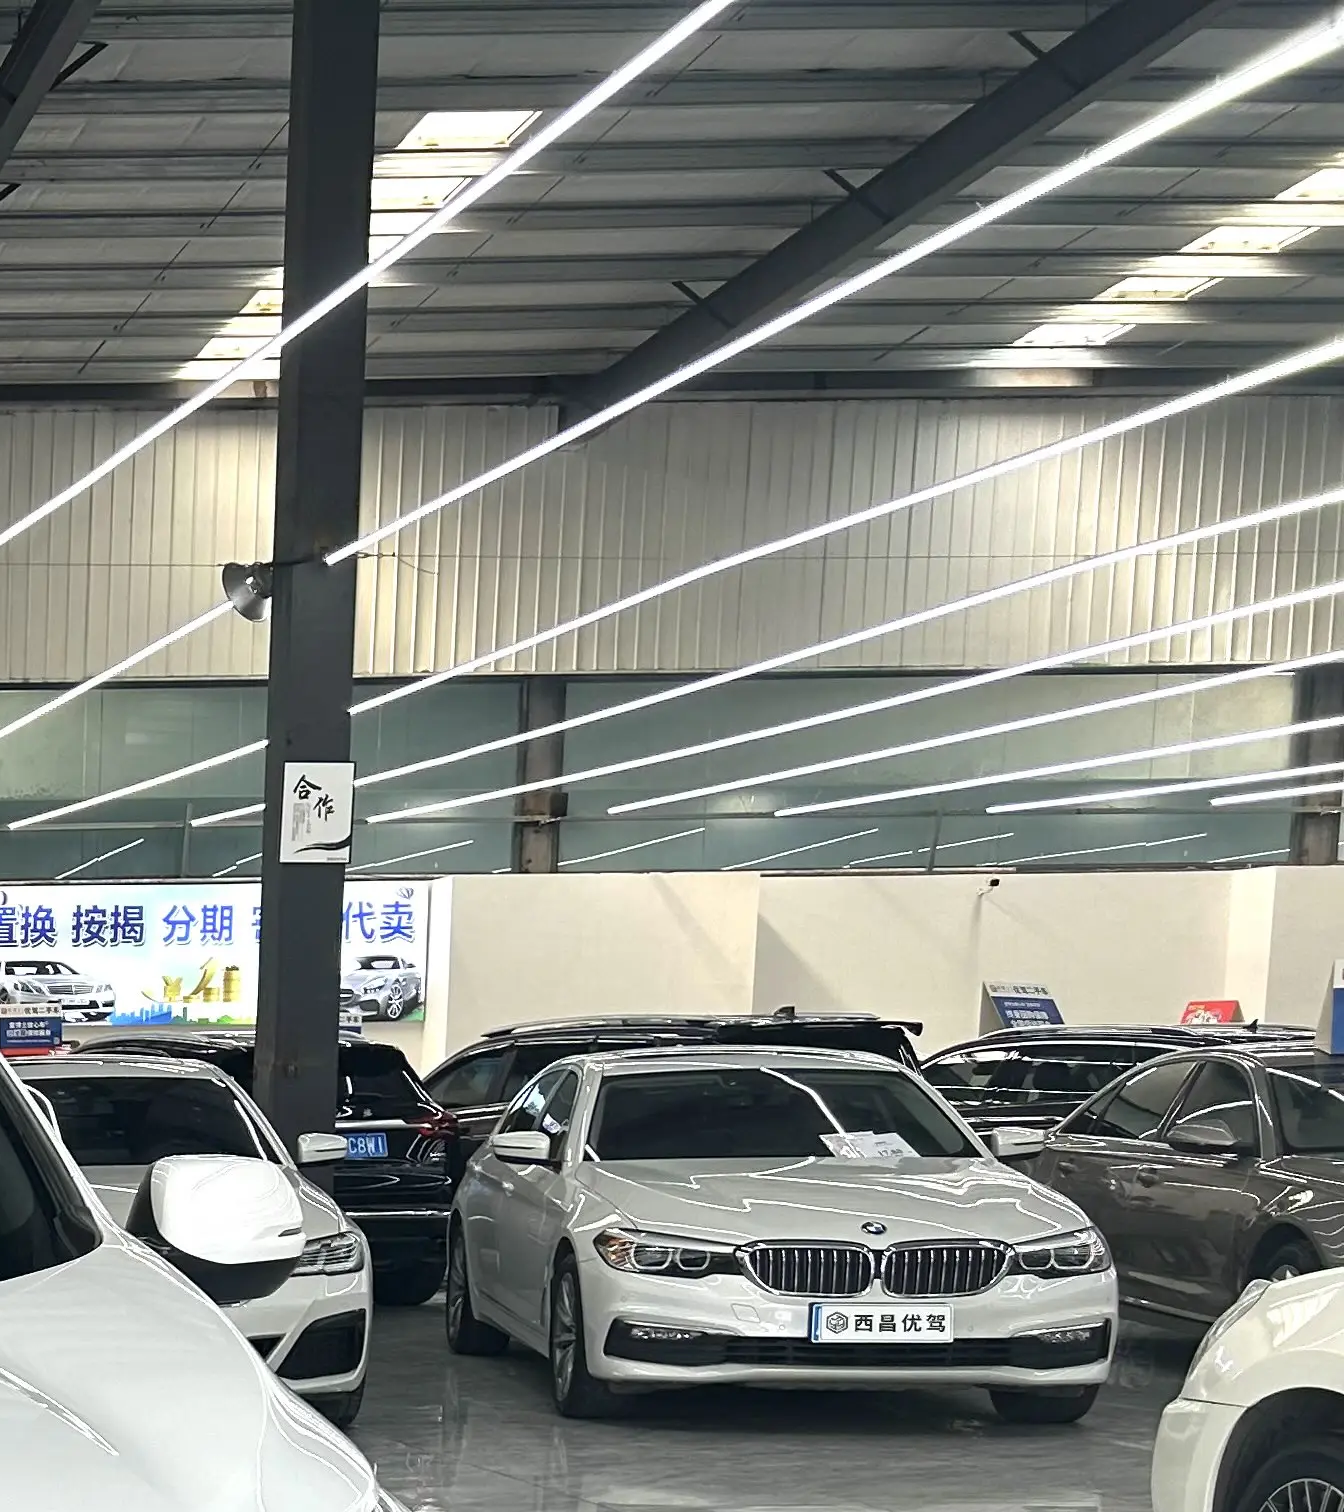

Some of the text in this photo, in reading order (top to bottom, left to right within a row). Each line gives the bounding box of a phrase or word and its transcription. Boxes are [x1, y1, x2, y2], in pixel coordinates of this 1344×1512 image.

[293, 774, 335, 822] 合作
[71, 905, 146, 945] 按揭
[162, 905, 234, 944] 分期
[854, 1314, 945, 1332] 西昌优驾
